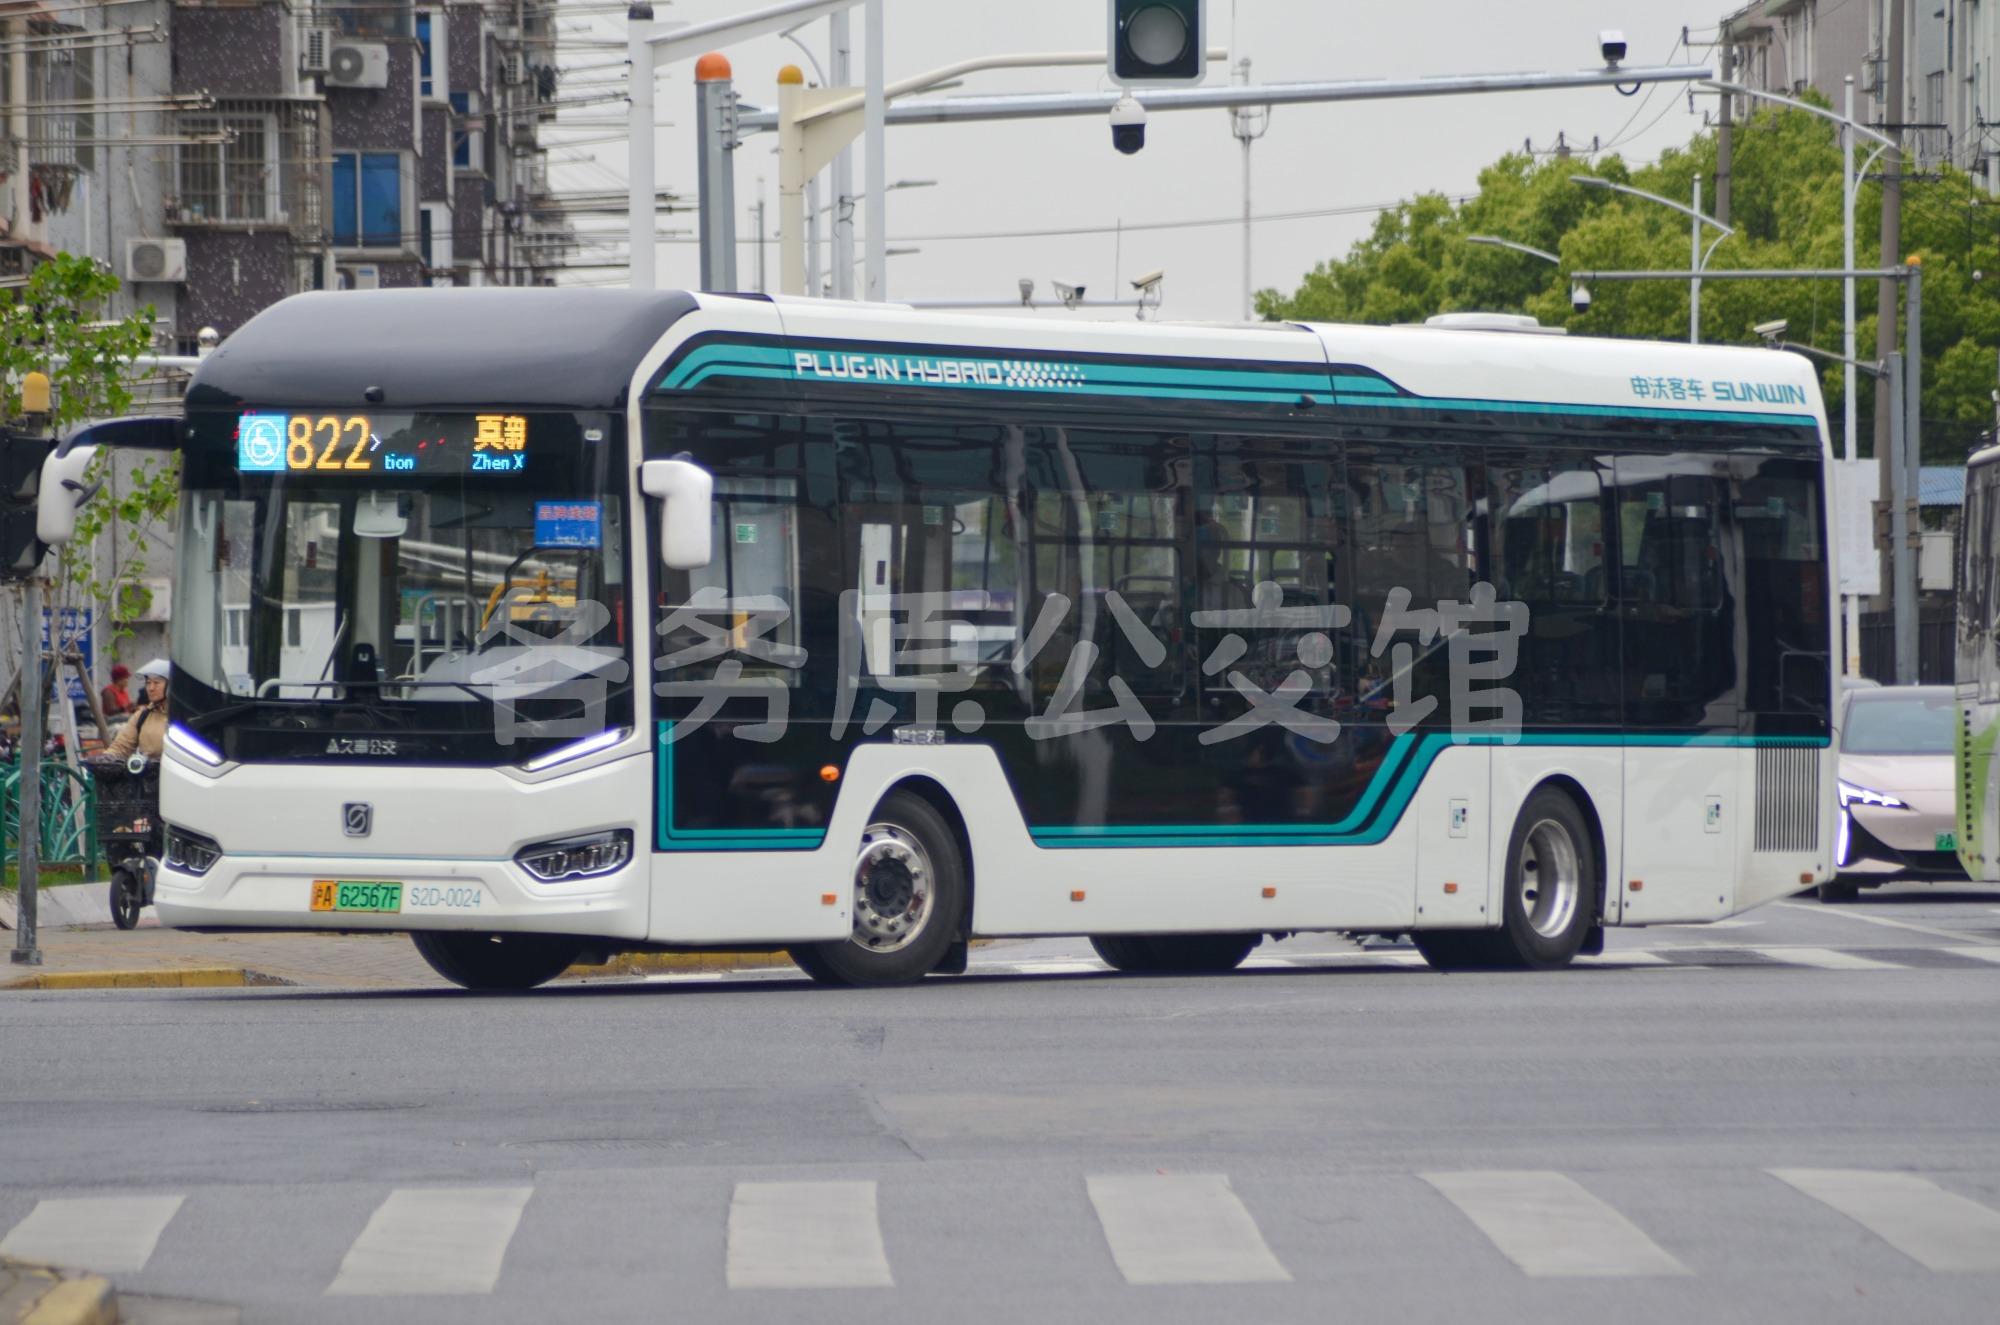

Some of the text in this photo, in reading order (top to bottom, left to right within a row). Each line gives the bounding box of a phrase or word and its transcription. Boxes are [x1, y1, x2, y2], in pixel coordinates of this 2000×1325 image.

[794, 353, 1003, 385] PLUG-IN HYBRID
[1630, 376, 1707, 401] 申沃客车
[1712, 381, 1807, 405] SUNWIN
[286, 416, 371, 470] 822
[384, 453, 414, 470] tion
[472, 453, 510, 470] Zhen
[410, 887, 481, 907] S2D-0024
